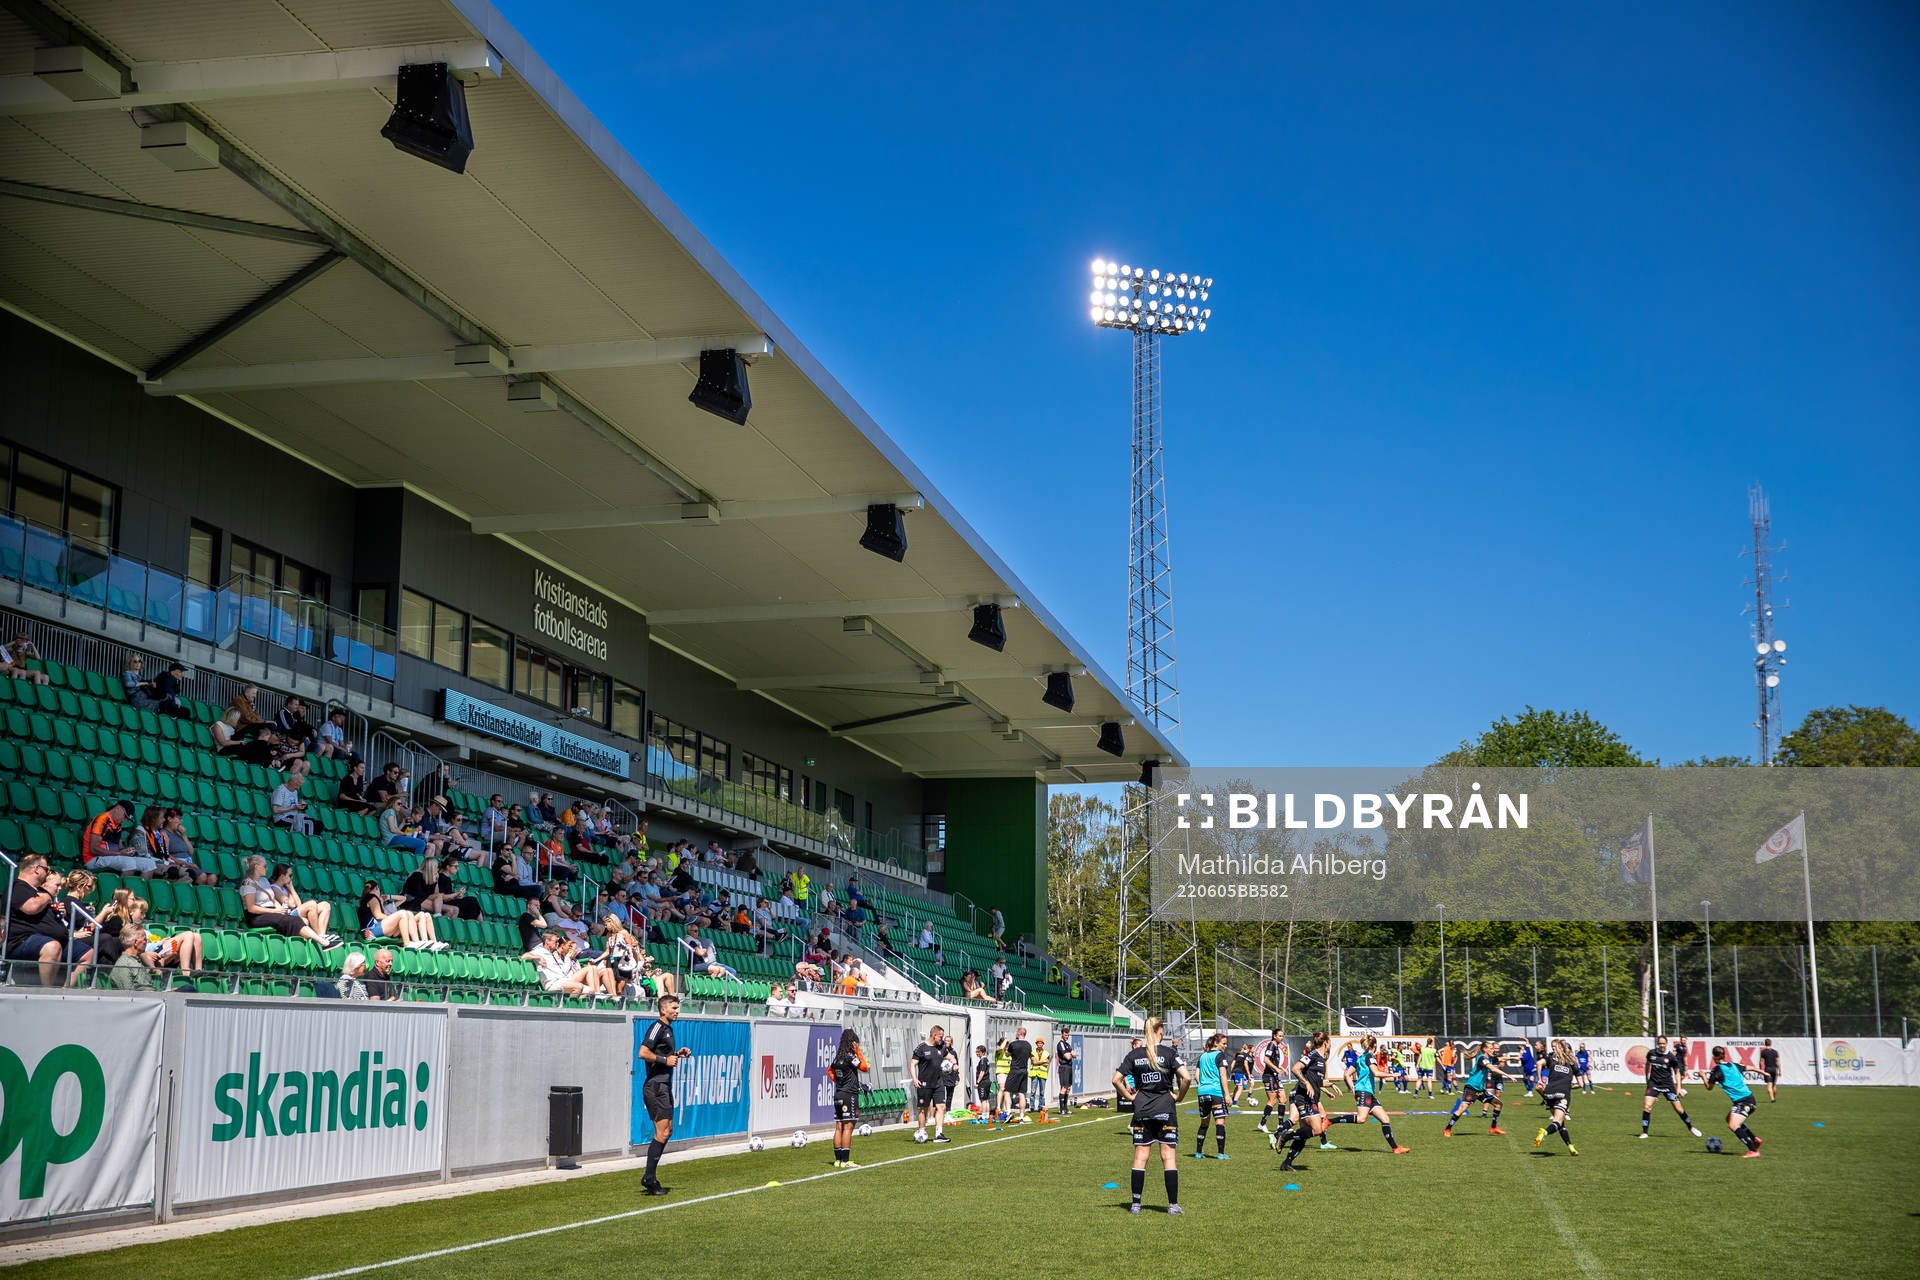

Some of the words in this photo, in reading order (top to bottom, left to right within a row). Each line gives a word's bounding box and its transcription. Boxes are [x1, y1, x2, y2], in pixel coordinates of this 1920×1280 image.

[534, 569, 608, 630] Kristianstads
[534, 603, 607, 661] fotbollsarena
[468, 704, 543, 749] Kristianstadsbladet
[559, 736, 622, 775] Kristianstadsbladet
[774, 1083, 788, 1099] SPEL
[775, 1063, 800, 1080] SVENSKA
